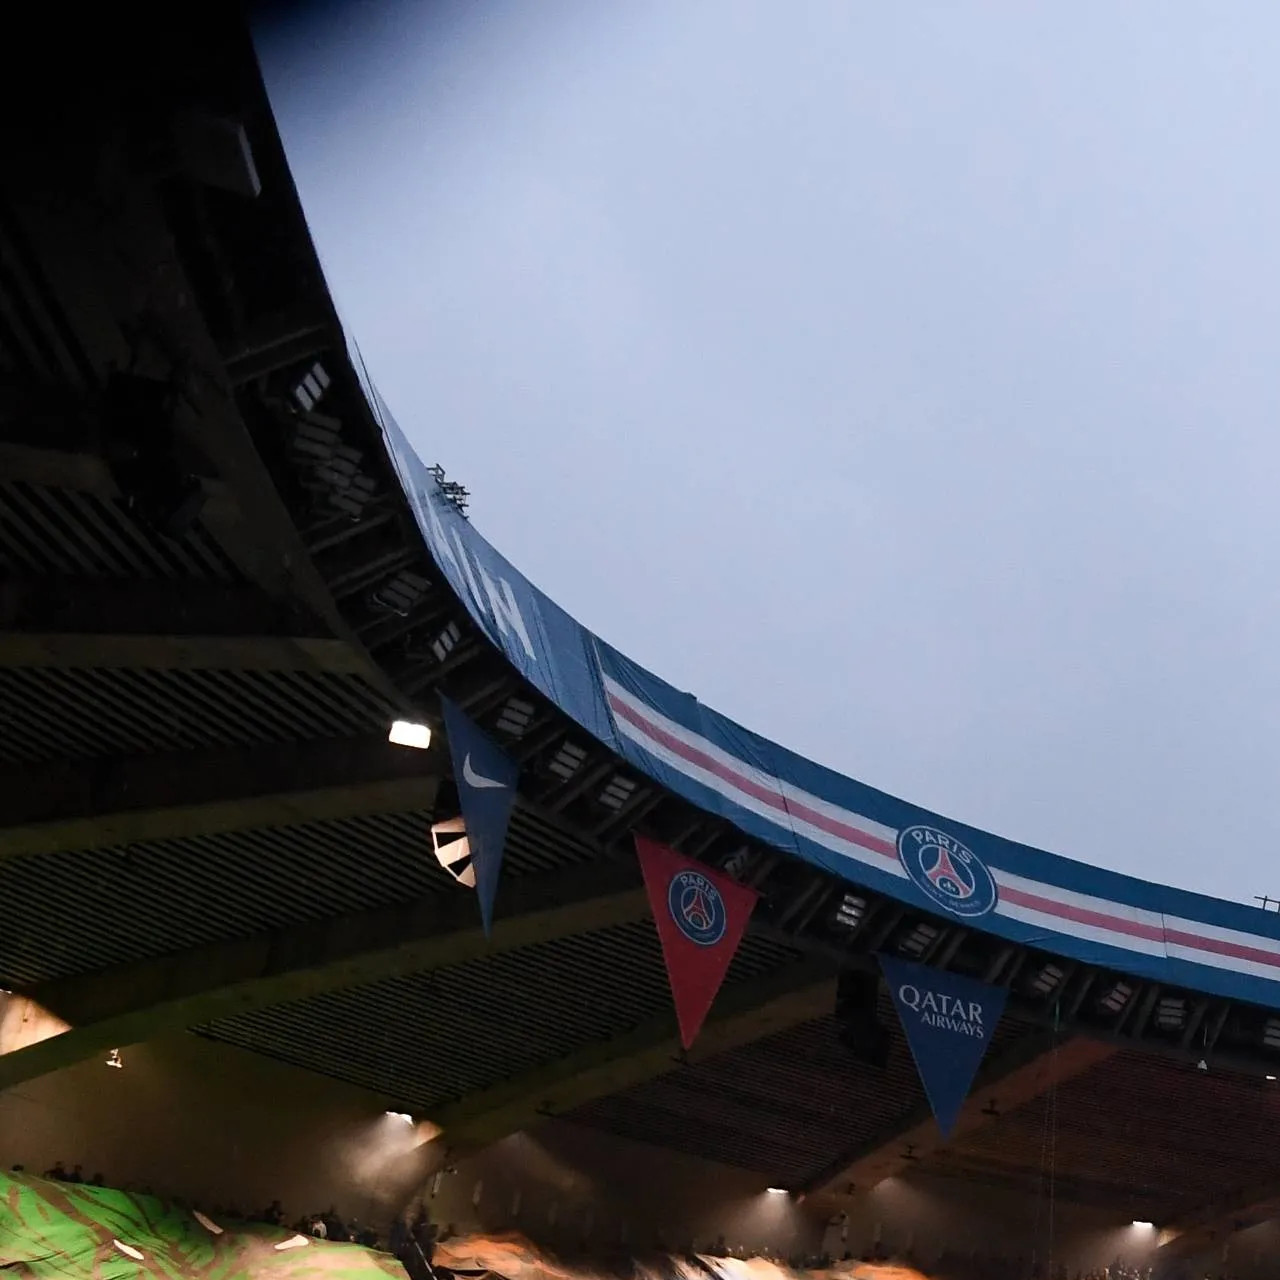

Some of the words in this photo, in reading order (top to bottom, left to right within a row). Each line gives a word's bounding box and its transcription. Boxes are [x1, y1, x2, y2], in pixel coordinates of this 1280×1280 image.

[911, 830, 973, 864] PARIS
[680, 875, 717, 901] PARIS
[899, 984, 983, 1024] QATAR
[921, 1011, 984, 1039] AIRWAYS
